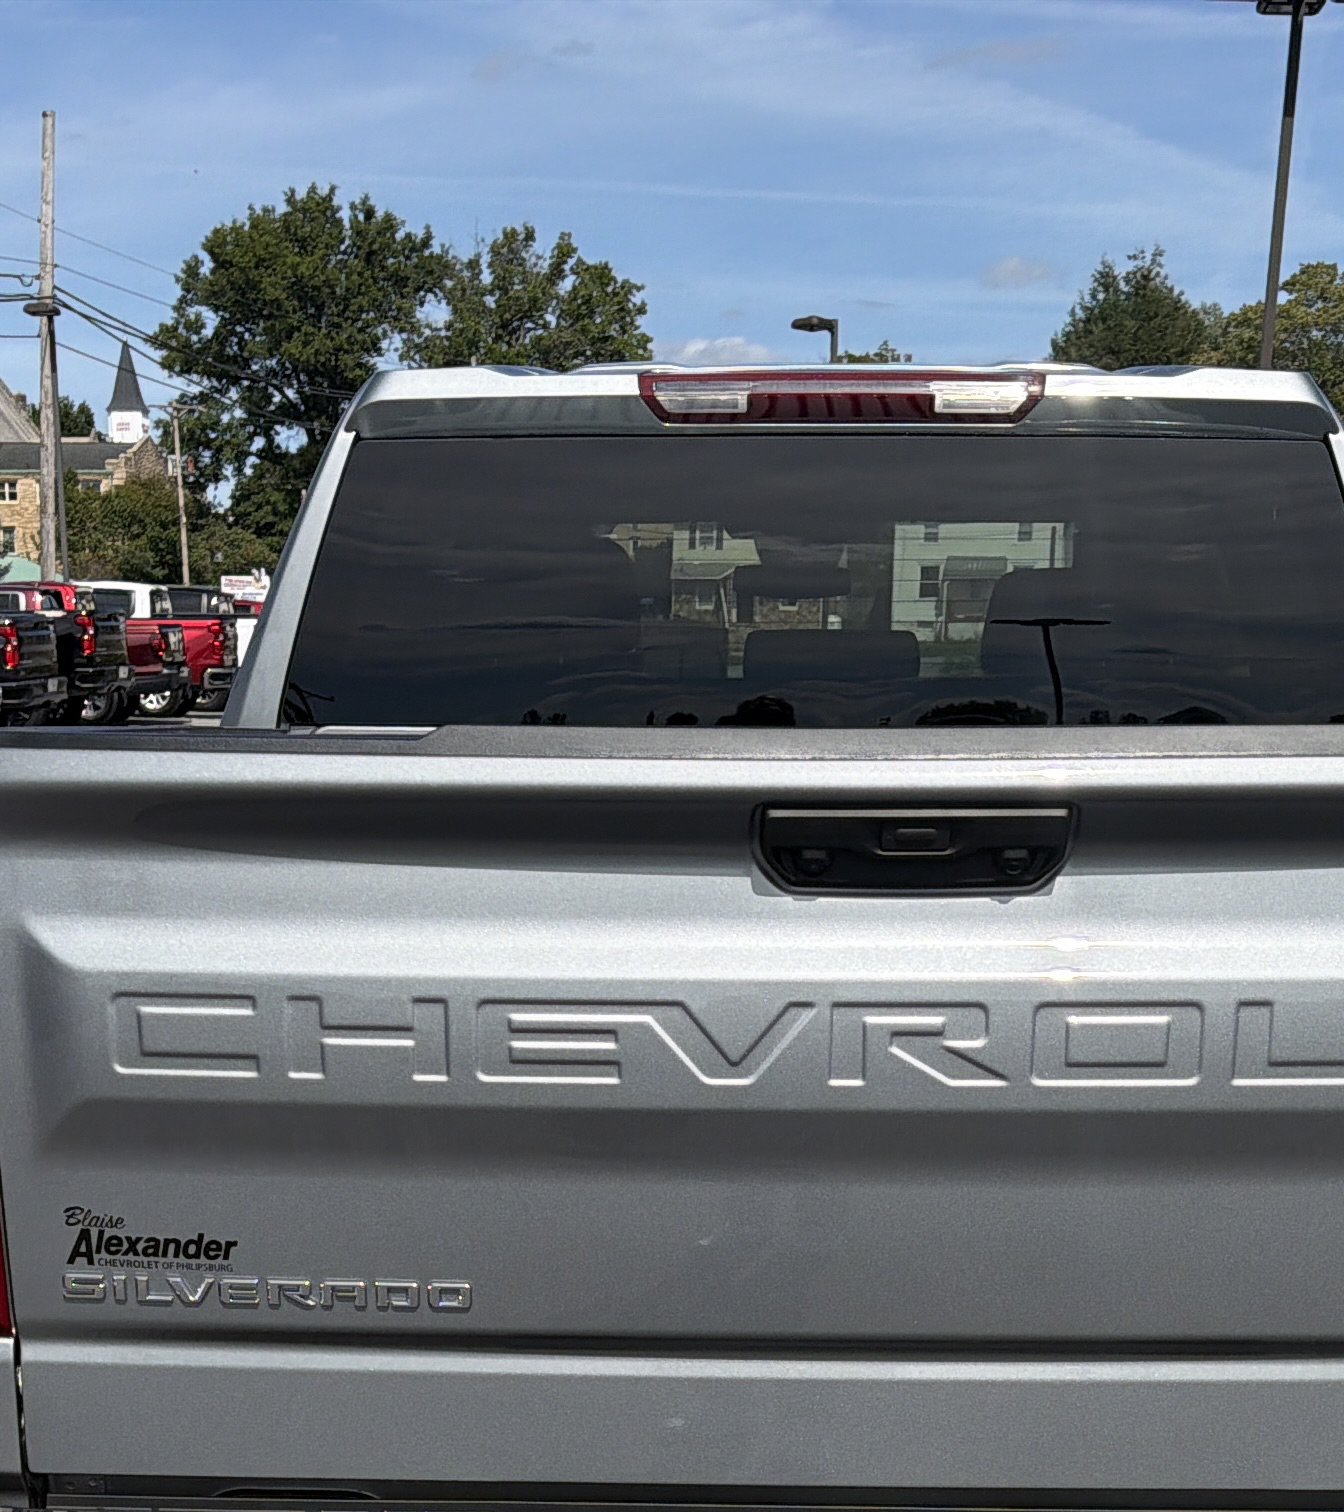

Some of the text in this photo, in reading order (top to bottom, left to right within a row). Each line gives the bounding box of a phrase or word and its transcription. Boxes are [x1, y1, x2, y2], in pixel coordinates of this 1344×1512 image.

[63, 1206, 127, 1229] Blaise
[66, 1228, 238, 1266] Alexander
[97, 1258, 234, 1273] CHEVROLET OF PHILIPSBURG
[62, 1271, 474, 1310] SILVERADO
